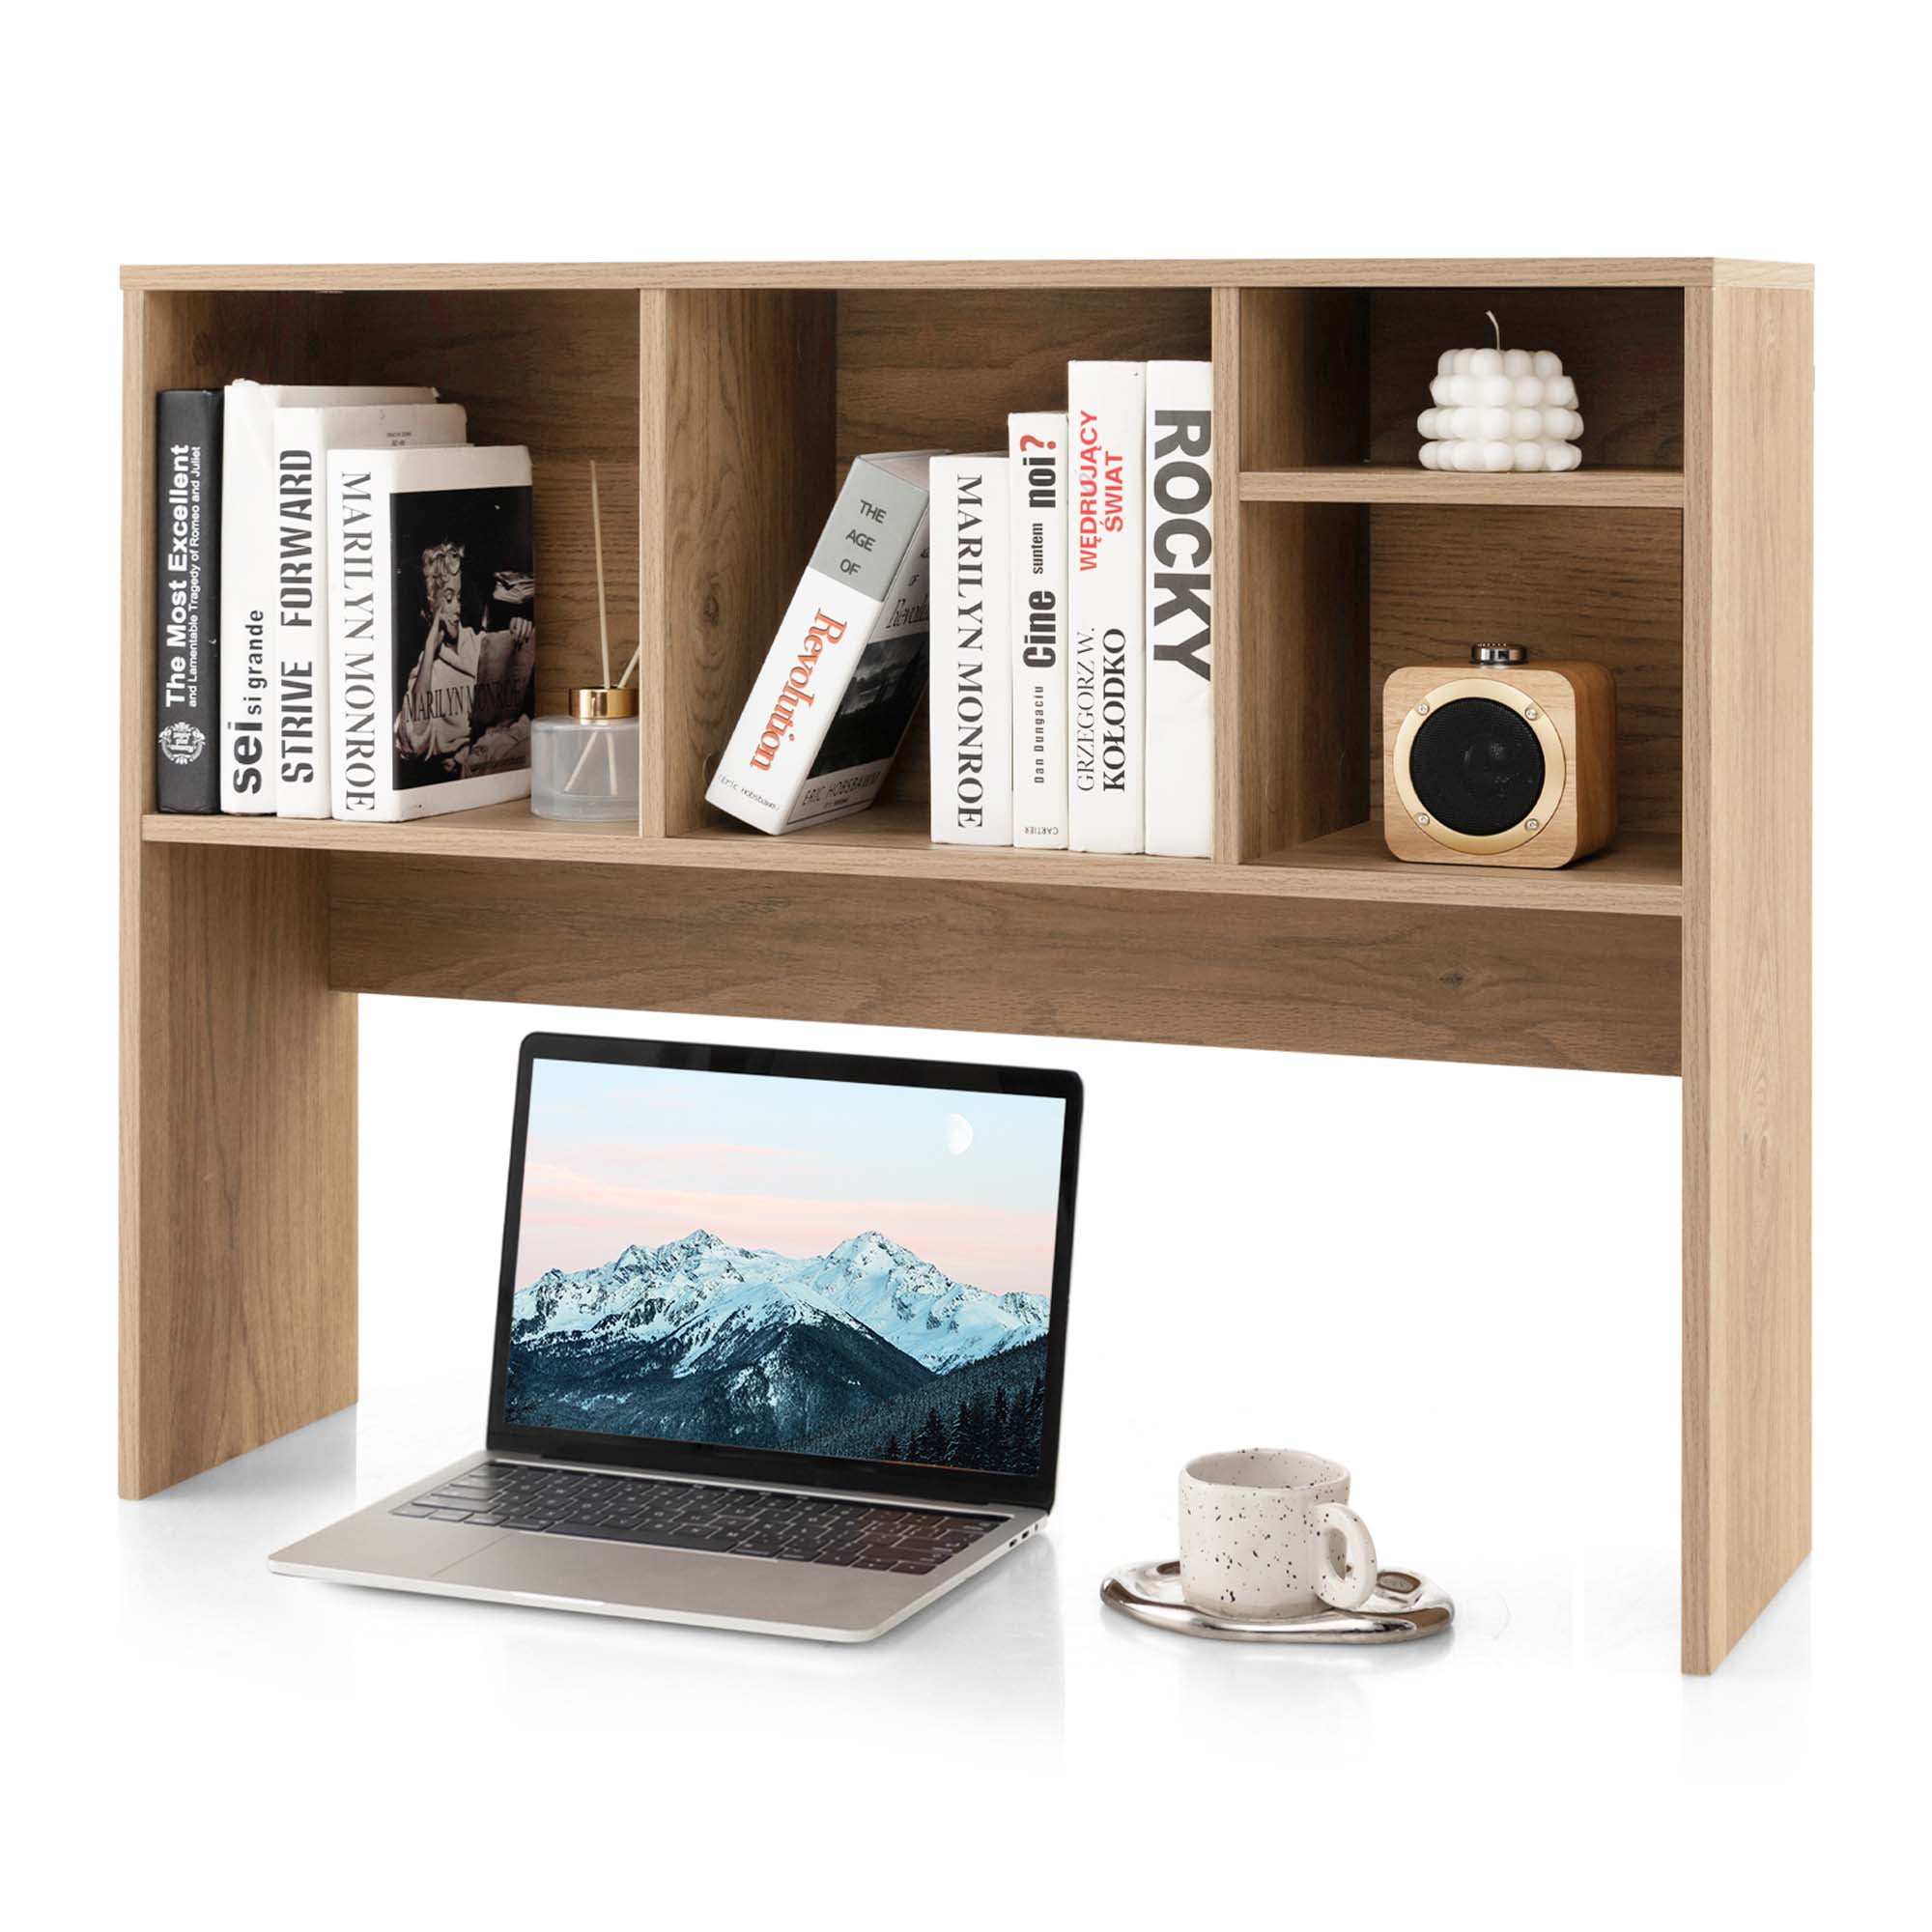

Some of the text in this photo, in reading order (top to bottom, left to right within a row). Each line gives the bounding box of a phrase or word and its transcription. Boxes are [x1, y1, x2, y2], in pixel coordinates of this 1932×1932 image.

[168, 444, 189, 572] Excellent
[839, 558, 861, 576] OF
[845, 528, 875, 552] AGE
[860, 499, 887, 525] THE
[1020, 435, 1057, 668] Cine suntem noi?
[1080, 410, 1101, 571] WĘDRUJĄCY
[1100, 451, 1123, 532] ŚWIAT
[1153, 411, 1212, 681] ROCKY
[166, 580, 187, 647] Most
[186, 446, 201, 708] and Lamentable Tragedy of Romeo and Juliet
[279, 449, 314, 783] STRIVE FORWARD
[342, 471, 377, 811] MARILYN MONROE
[957, 474, 983, 828] MARILYN MONROE
[165, 656, 186, 707] The
[227, 610, 268, 794] sei si grande
[405, 686, 465, 723] MARILYN
[750, 608, 848, 771] Revolution
[1034, 686, 1045, 784] Dan Dungaciu
[1076, 627, 1094, 792] GRZEGORZ W.
[1102, 628, 1126, 792] KOŁODKO
[1024, 826, 1060, 835] CARTIER
